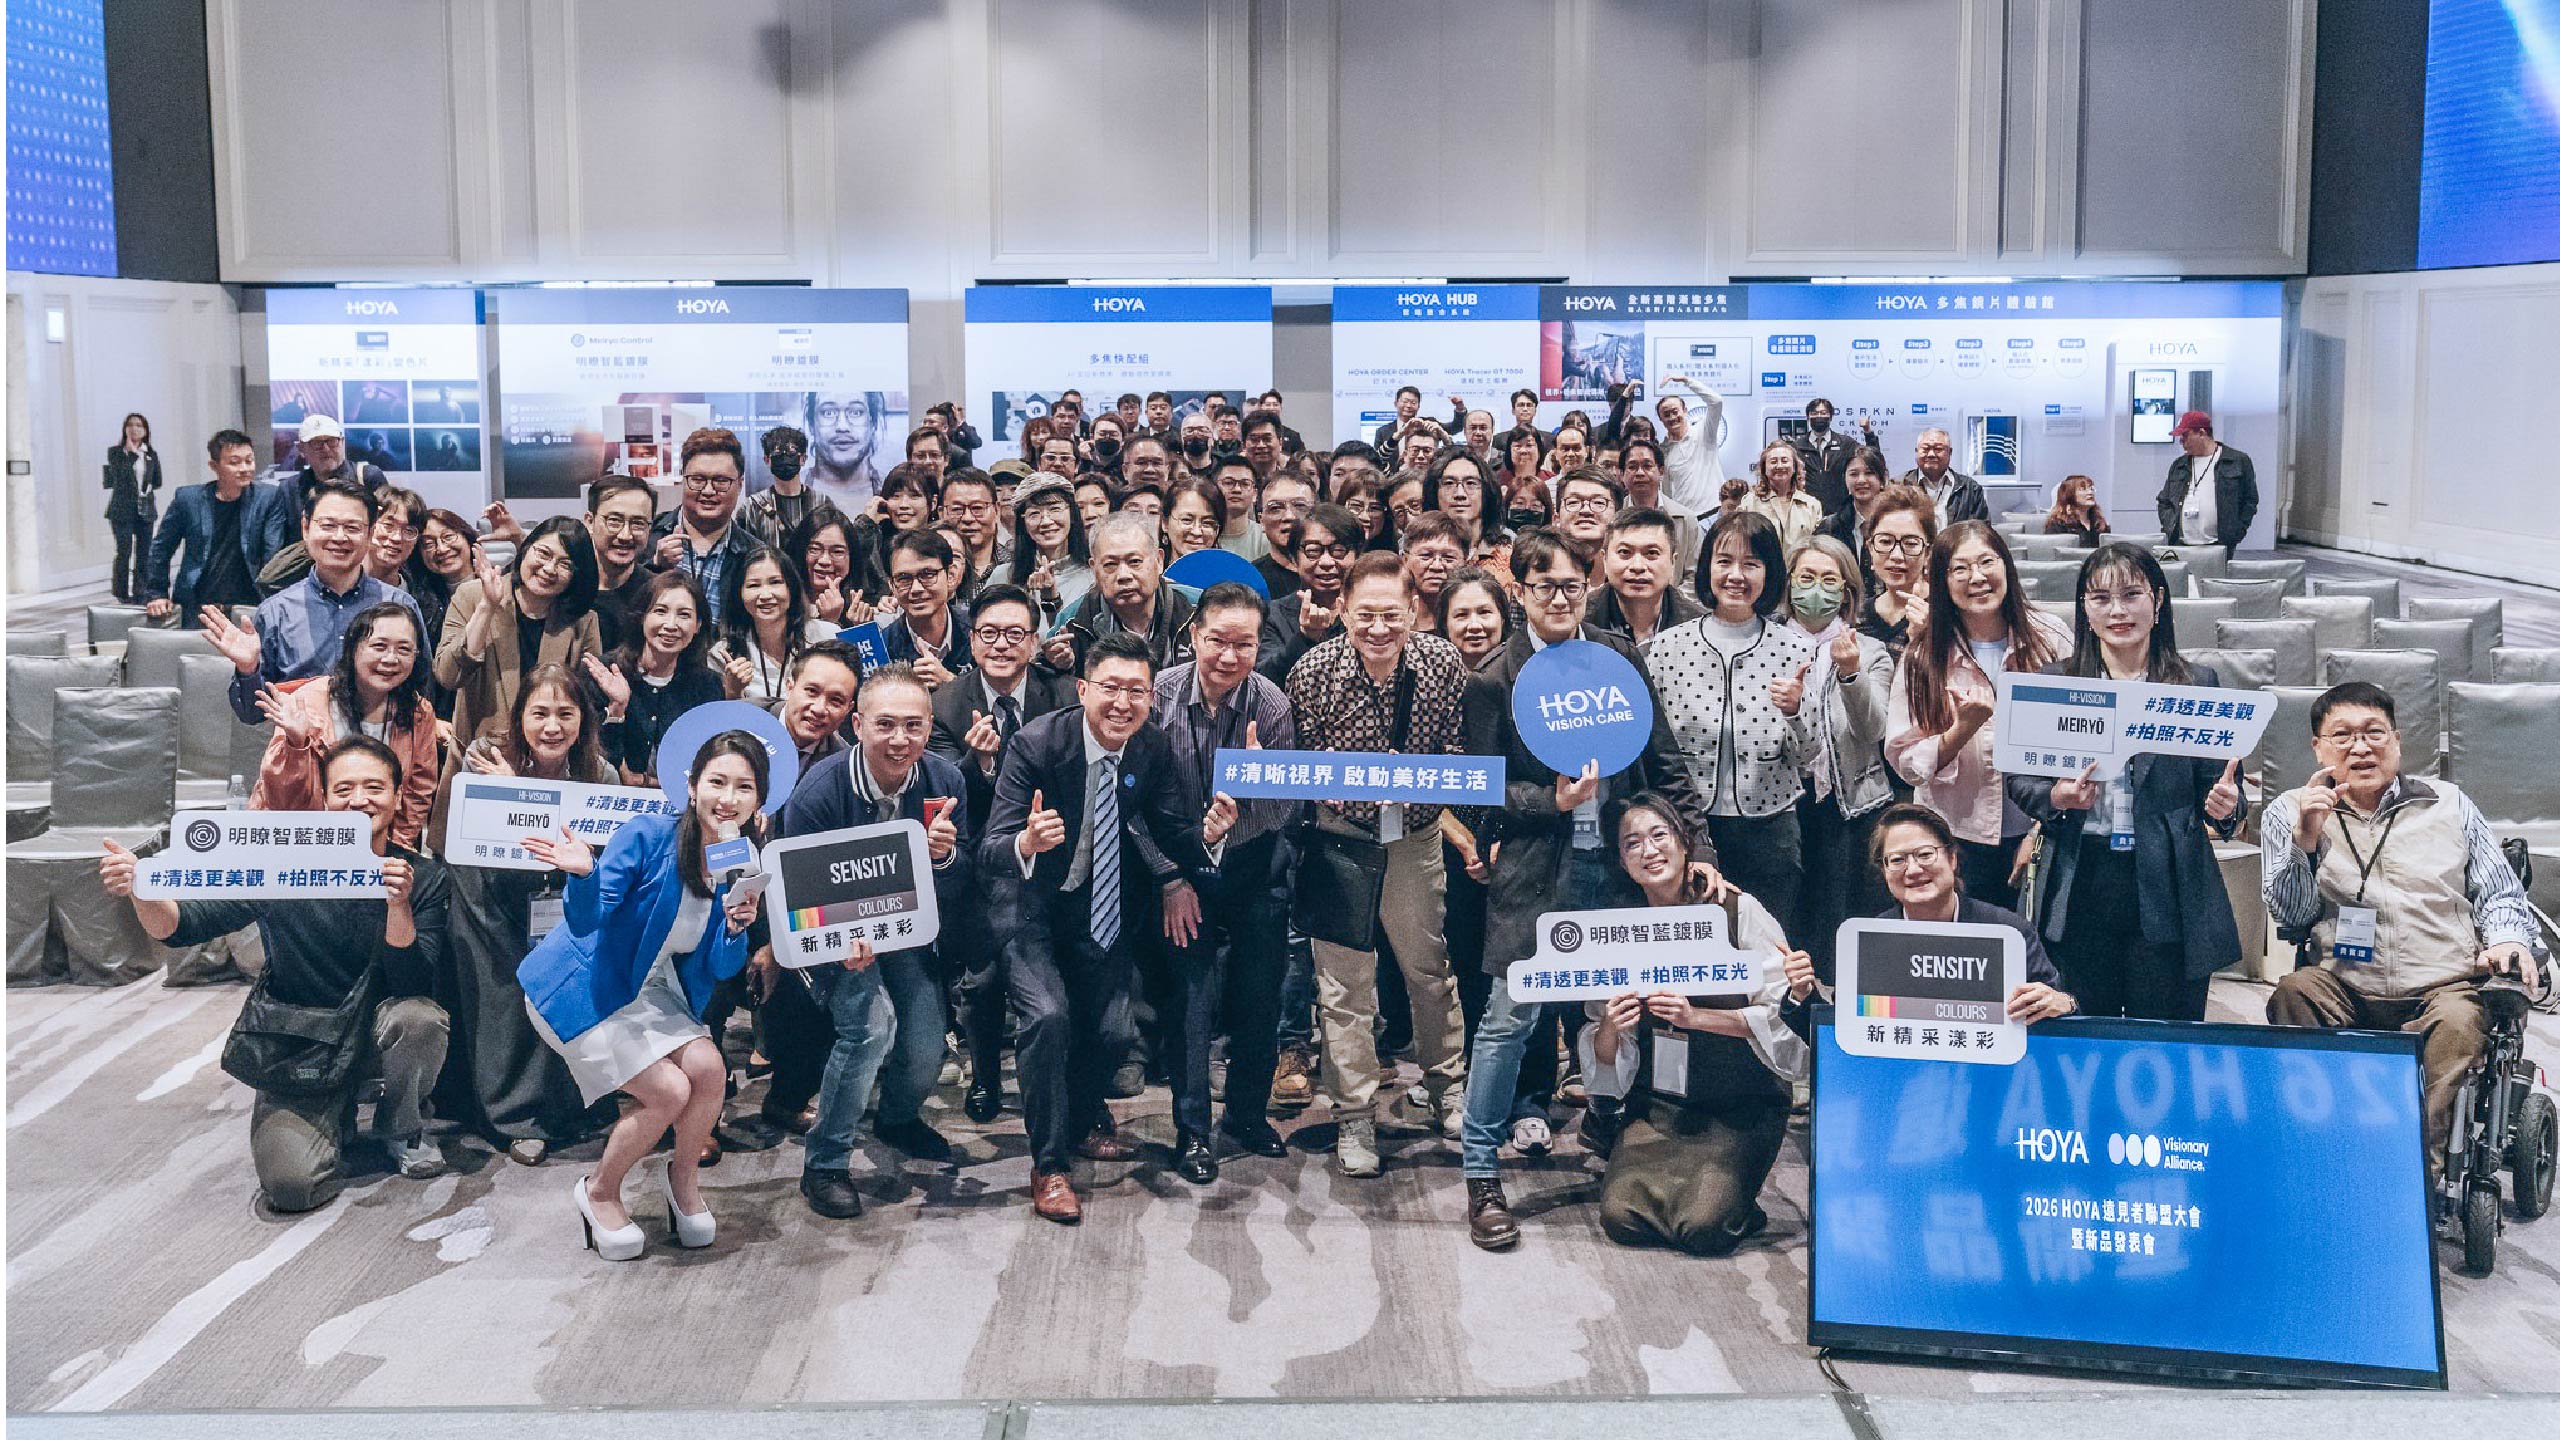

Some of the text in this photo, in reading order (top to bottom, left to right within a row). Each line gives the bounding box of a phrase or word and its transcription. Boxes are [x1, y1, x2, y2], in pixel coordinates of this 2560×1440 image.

[345, 301, 399, 315] HOYA
[677, 299, 731, 314] HOYA
[1093, 297, 1146, 312] HOYA
[1397, 294, 1478, 305] HOYA HUB
[1564, 295, 1616, 311] HOYA
[1875, 295, 1928, 310] HOYA
[2149, 343, 2198, 355] HOYA
[1536, 685, 1630, 718] HOYA
[2069, 691, 2107, 705] HI-VISION
[2144, 697, 2256, 721] #清透更美觀
[1545, 709, 1634, 732] VISION CARE
[2125, 722, 2235, 747] #拍照不反光
[1225, 761, 1487, 791] #清晰視界 啟動美好生活
[229, 827, 356, 846] 明瞭智藍鍍膜
[150, 868, 386, 887] #清透更美觀 #拍照不反光
[830, 853, 898, 884] SENSITY
[858, 896, 903, 916] COLOURS
[1590, 920, 1713, 945] 明瞭智藍鍍膜
[1522, 962, 1749, 989] #清透更美觀 #拍照不反光
[1910, 954, 1988, 981] SENSITY
[1935, 1003, 1987, 1021] COLOURS
[1867, 1024, 1995, 1050] 新精采漾彩
[2014, 1128, 2089, 1164] HOYA
[2163, 1137, 2209, 1157] Visionary
[2025, 1197, 2201, 1228] 2026 HOYA 遠見者聯盟大會
[2071, 1227, 2156, 1256] 暨新品發表會
